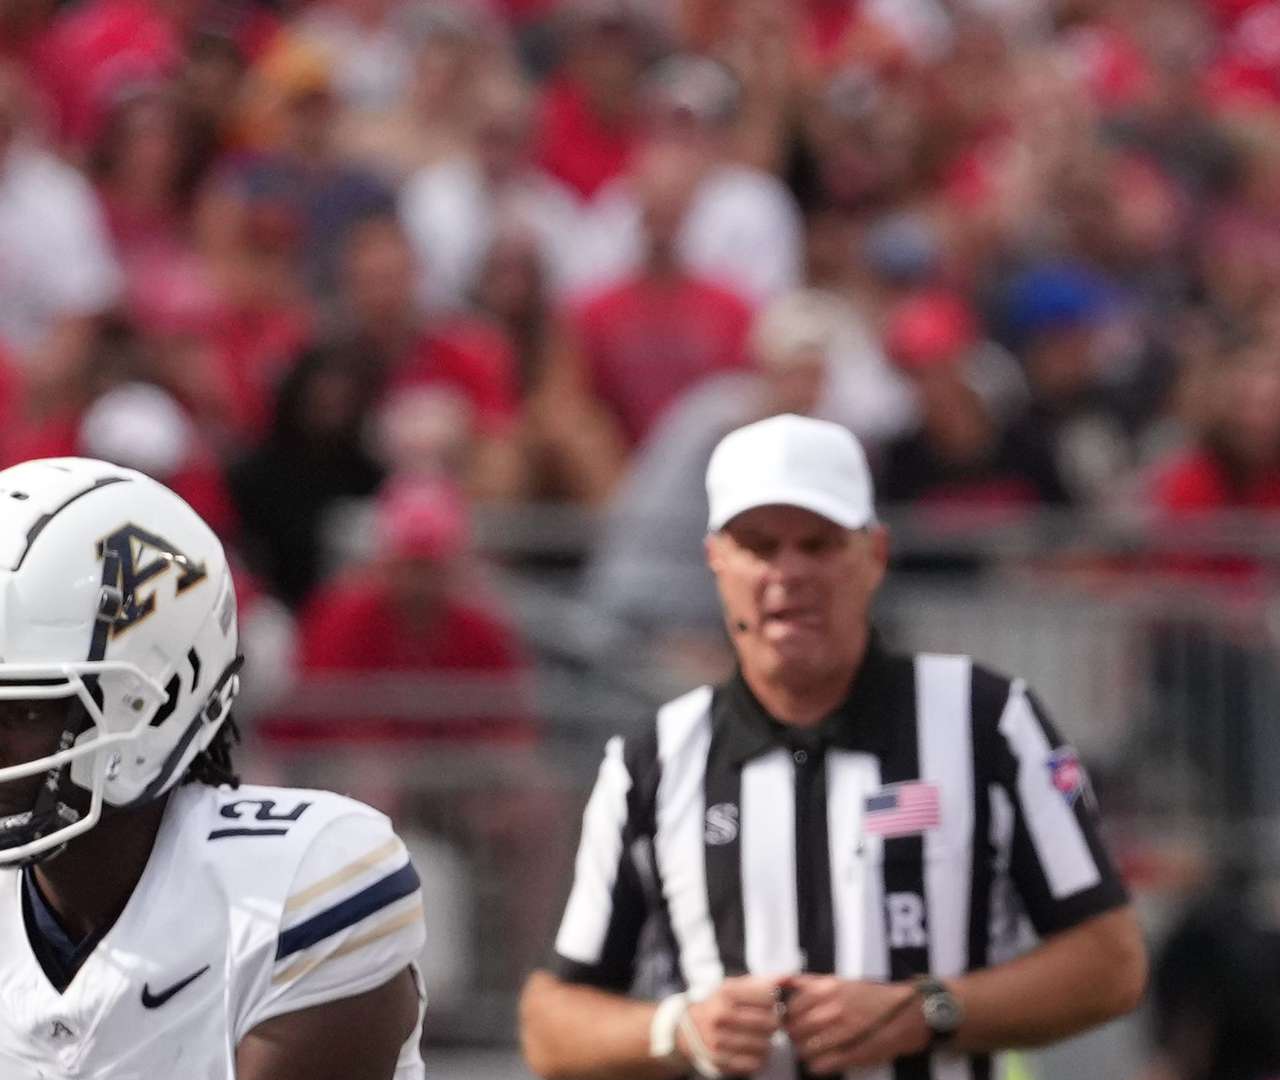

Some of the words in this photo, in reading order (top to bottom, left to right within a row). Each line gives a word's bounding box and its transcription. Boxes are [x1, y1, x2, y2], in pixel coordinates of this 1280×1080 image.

[95, 521, 207, 641] A
[207, 798, 314, 842] 12
[888, 892, 926, 948] R
